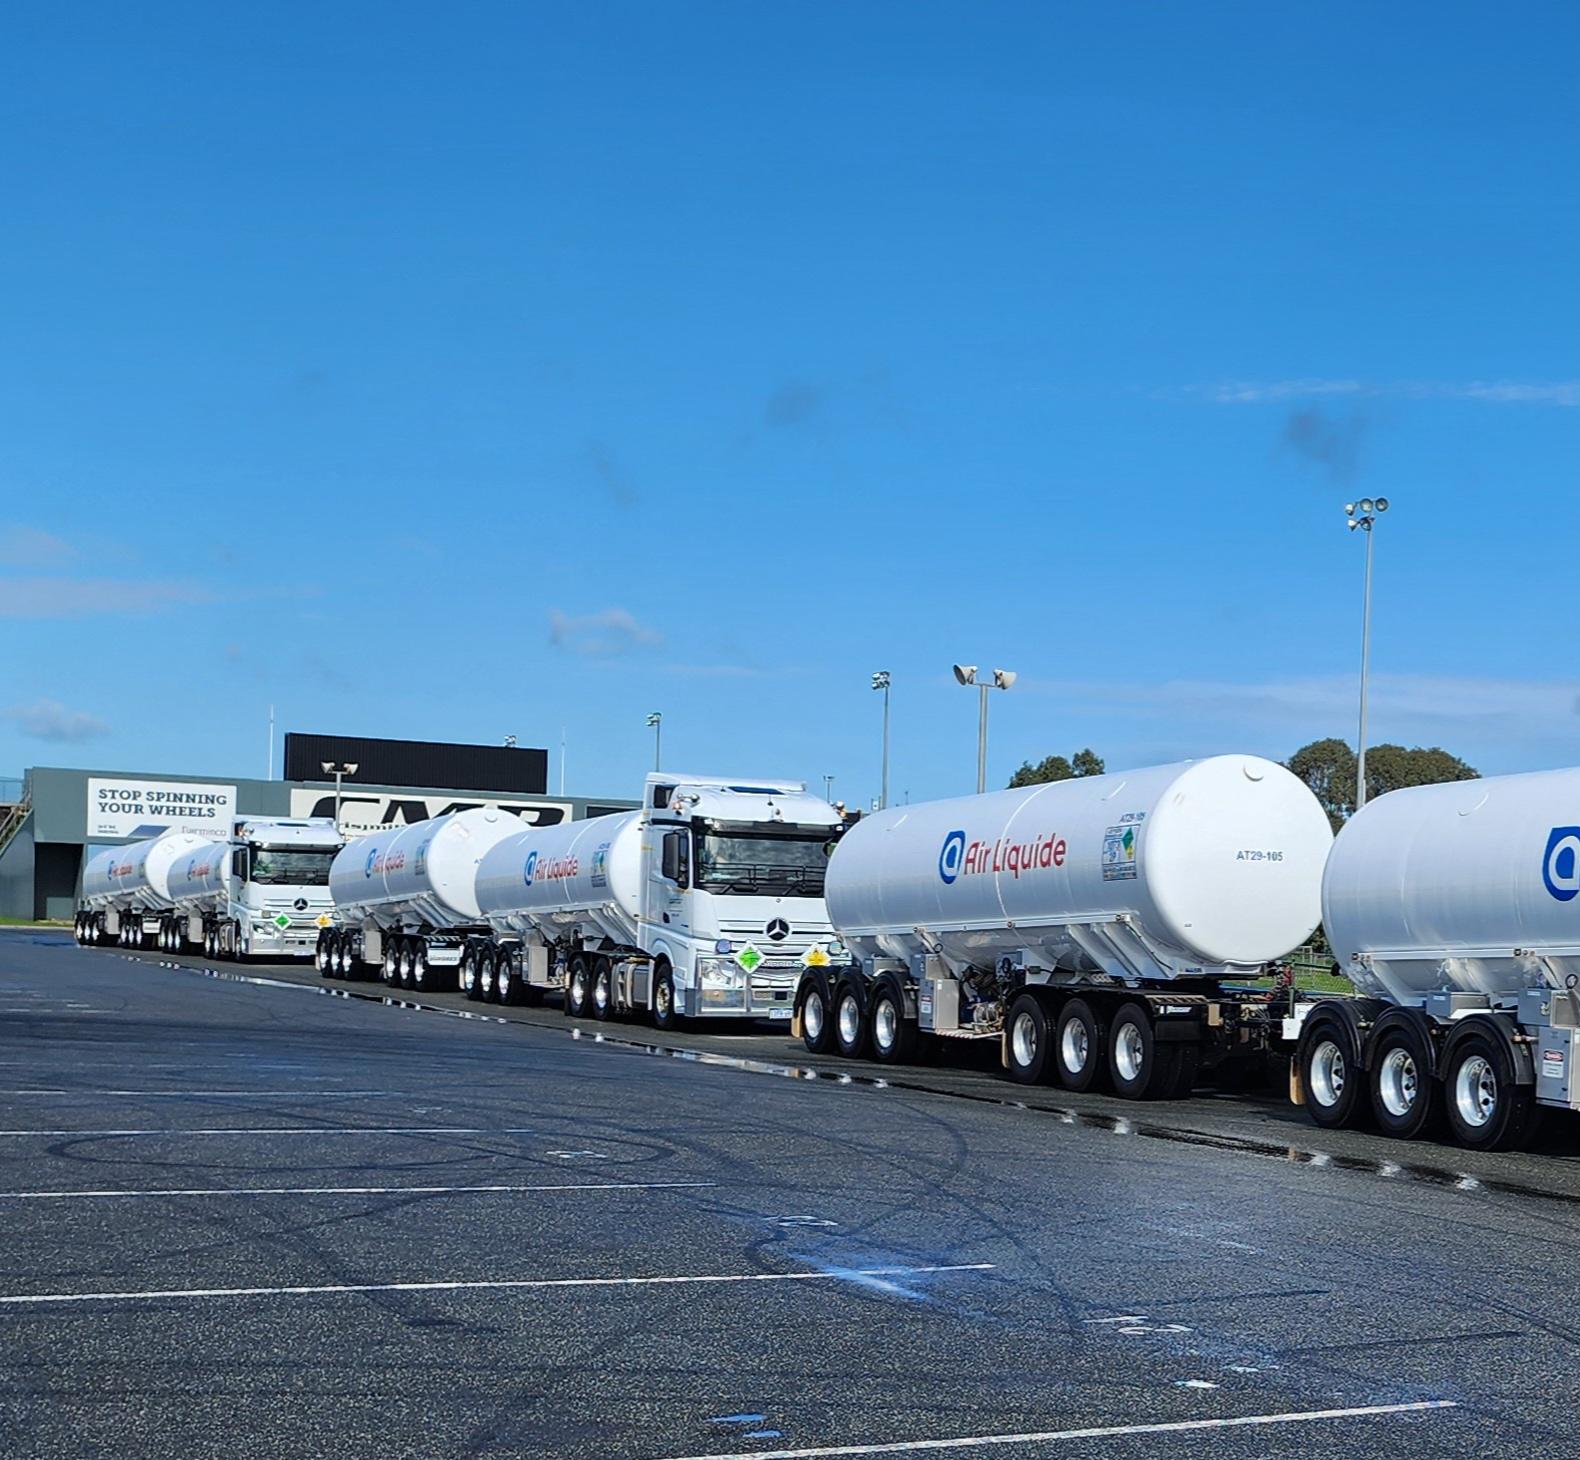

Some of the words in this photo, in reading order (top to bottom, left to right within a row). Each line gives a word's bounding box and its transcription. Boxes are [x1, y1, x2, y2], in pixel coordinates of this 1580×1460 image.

[98, 788, 142, 801] STOP
[146, 791, 227, 805] SPINNING
[98, 802, 144, 815] YOUR
[149, 805, 216, 818] WHEELS
[964, 841, 991, 875] Air
[992, 832, 1066, 879] Liquide
[1236, 850, 1283, 861] AT29-105
